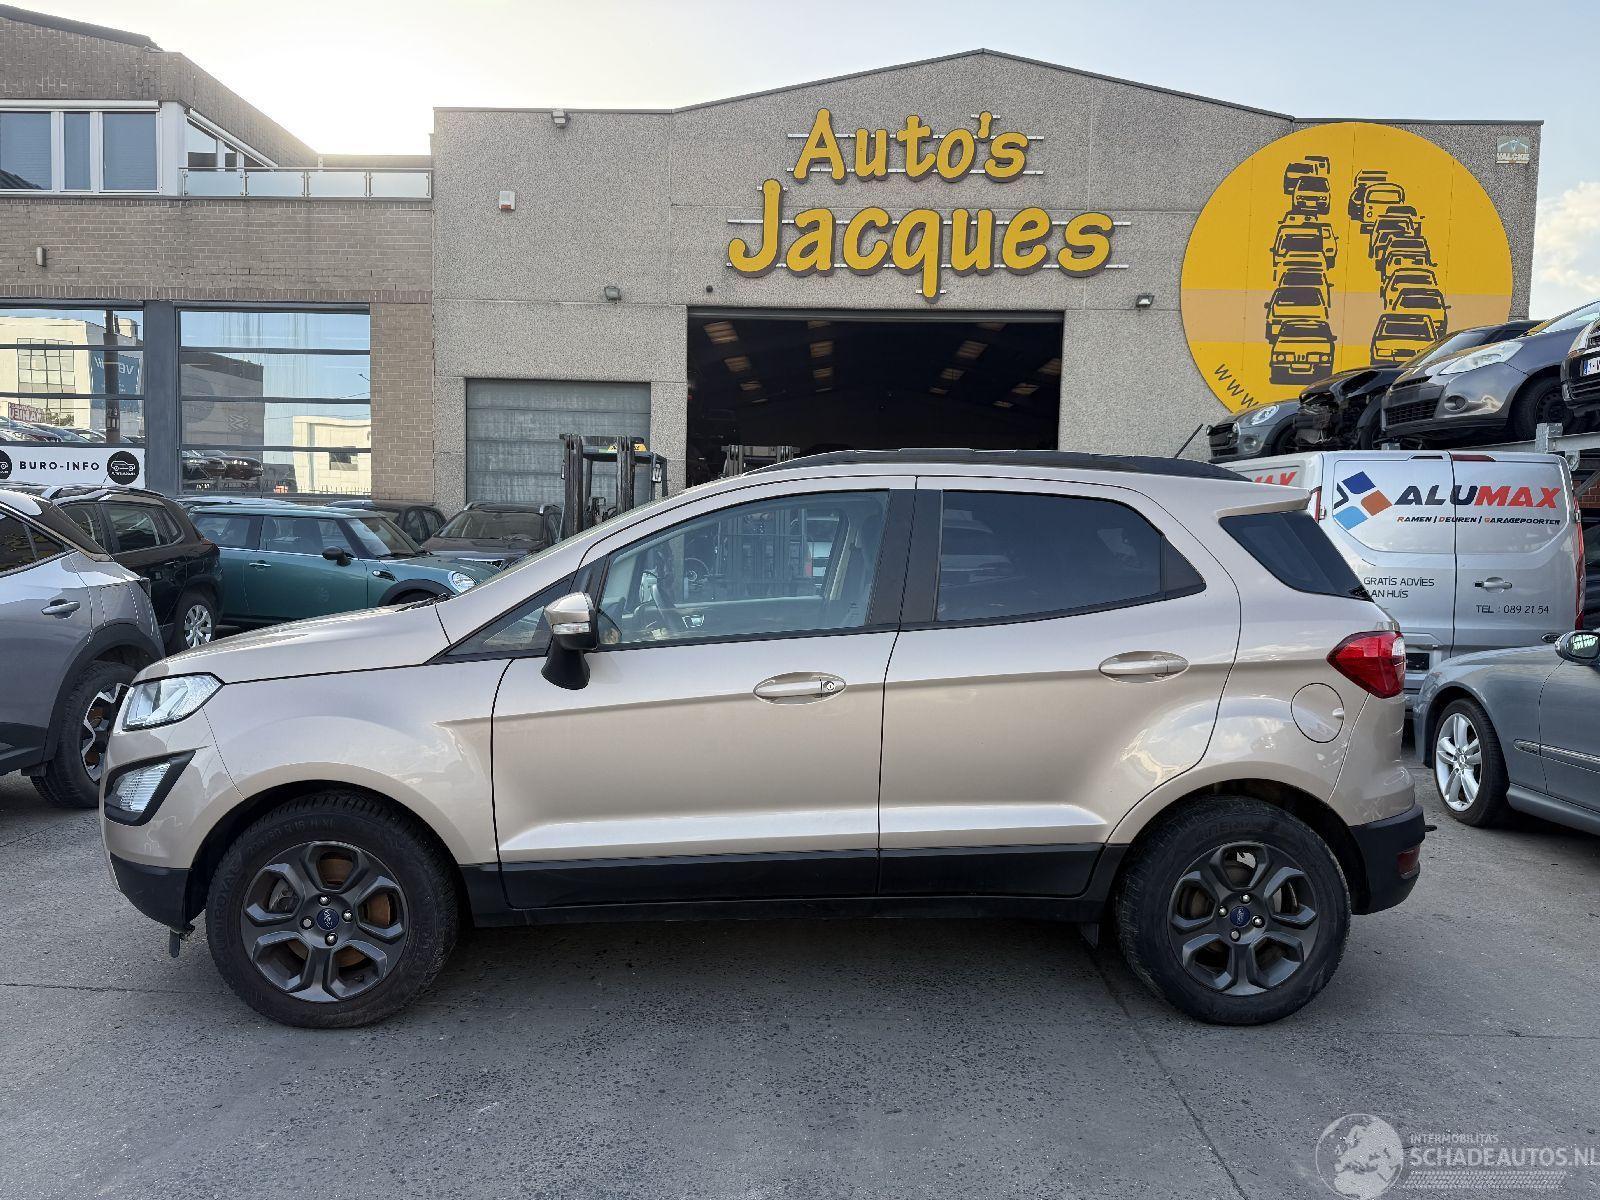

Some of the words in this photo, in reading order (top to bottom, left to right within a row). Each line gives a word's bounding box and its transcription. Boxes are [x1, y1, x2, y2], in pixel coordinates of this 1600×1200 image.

[793, 107, 1030, 184] Auto's
[728, 178, 1115, 303] Jacques
[19, 461, 100, 471] BURO-INFO
[1393, 484, 1561, 508] ALUMAX
[1475, 604, 1495, 614] TEL
[1503, 604, 1522, 614] 089
[1537, 605, 1550, 615] 54
